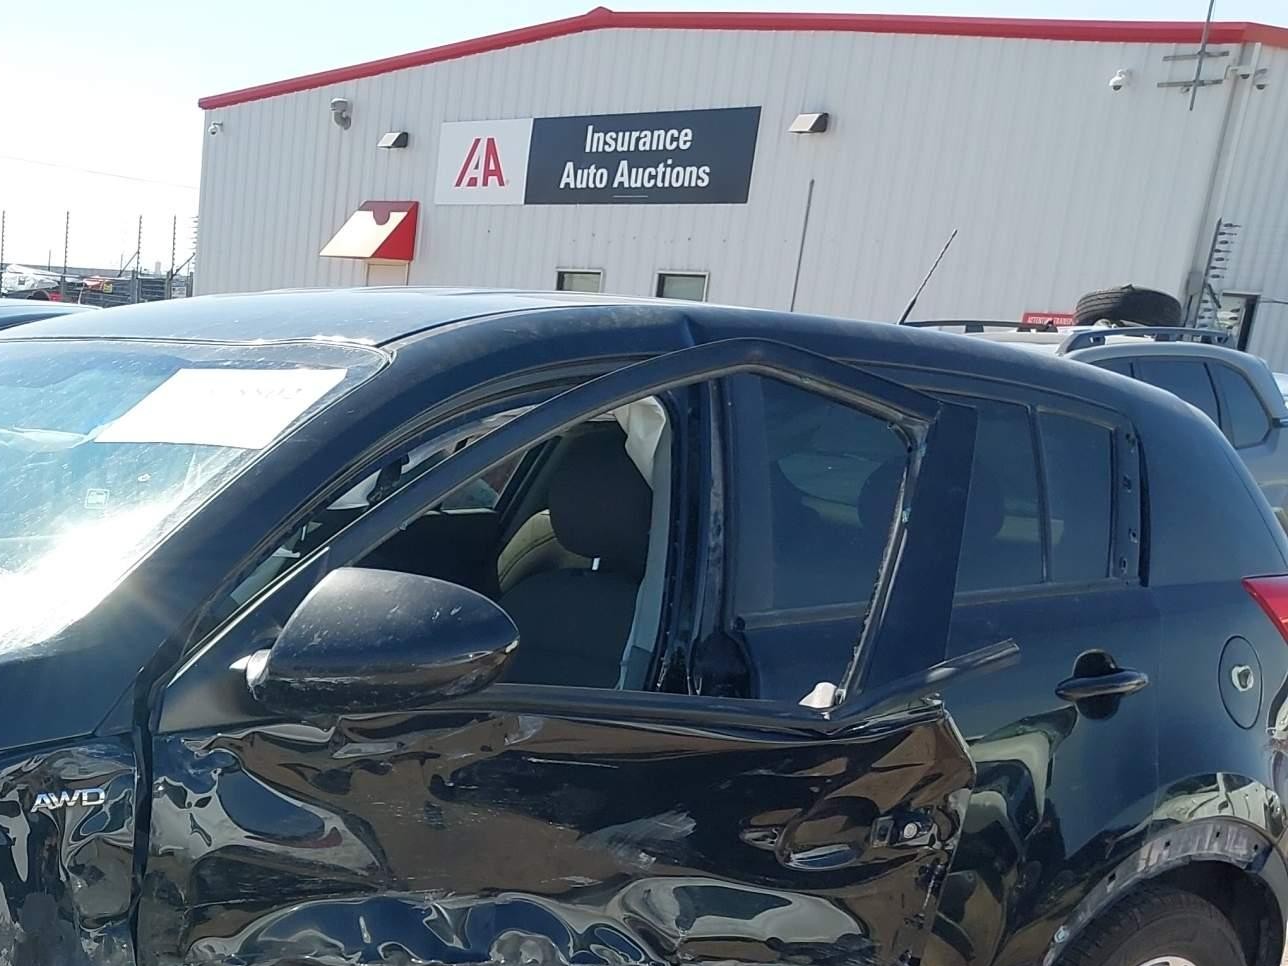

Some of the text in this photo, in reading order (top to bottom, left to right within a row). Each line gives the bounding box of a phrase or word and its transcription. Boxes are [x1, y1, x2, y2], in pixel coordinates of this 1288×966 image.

[585, 125, 692, 152] Insurance
[560, 158, 710, 189] Auto Auctions
[30, 788, 106, 812] AWD
